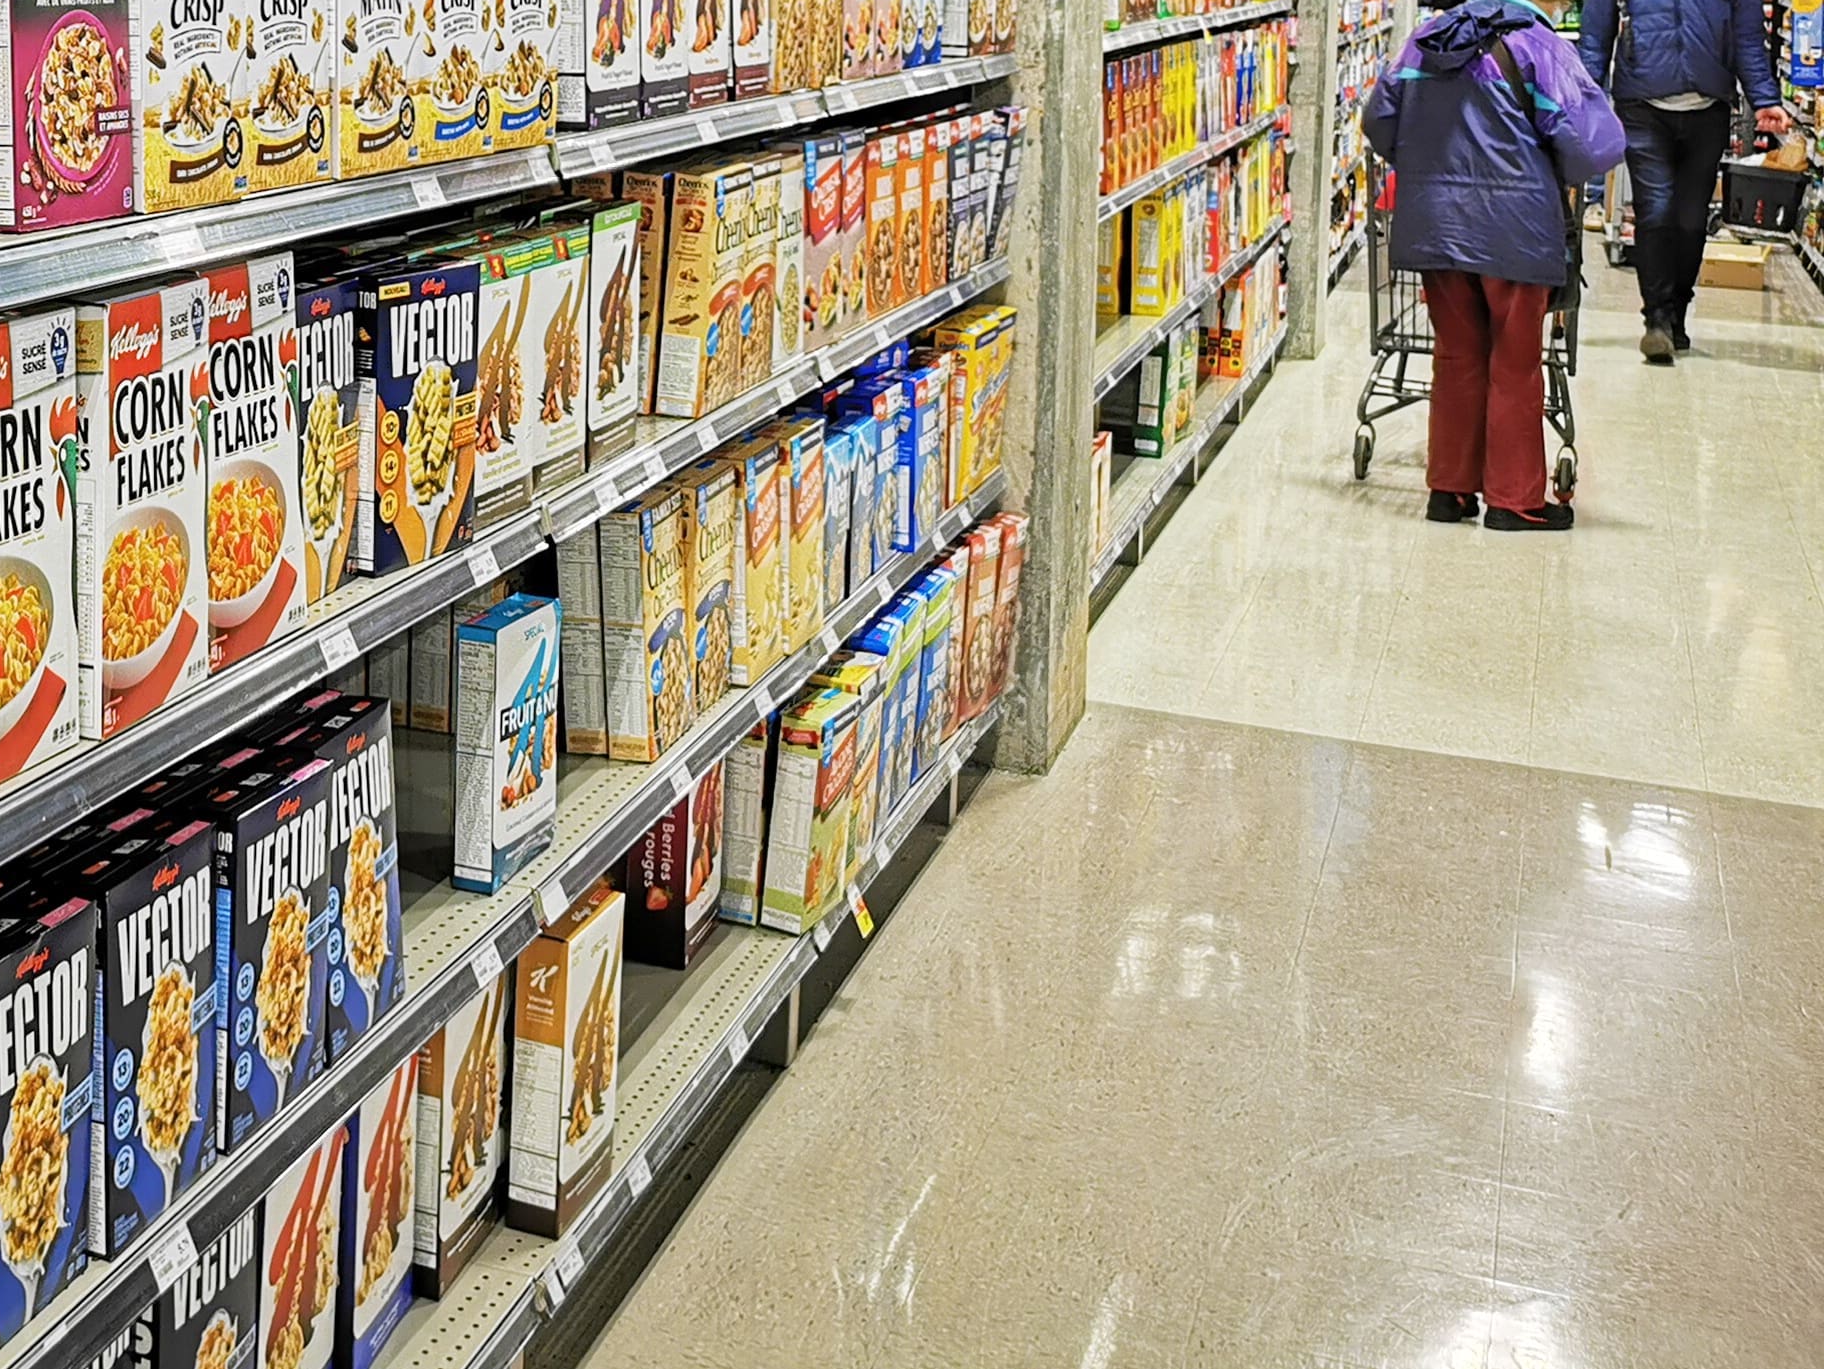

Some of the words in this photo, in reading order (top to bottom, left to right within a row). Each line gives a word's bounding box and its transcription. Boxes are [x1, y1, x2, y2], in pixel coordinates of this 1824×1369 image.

[388, 291, 475, 382] VECTOR
[501, 694, 536, 734] FRUIT
[660, 823, 675, 880] Berries
